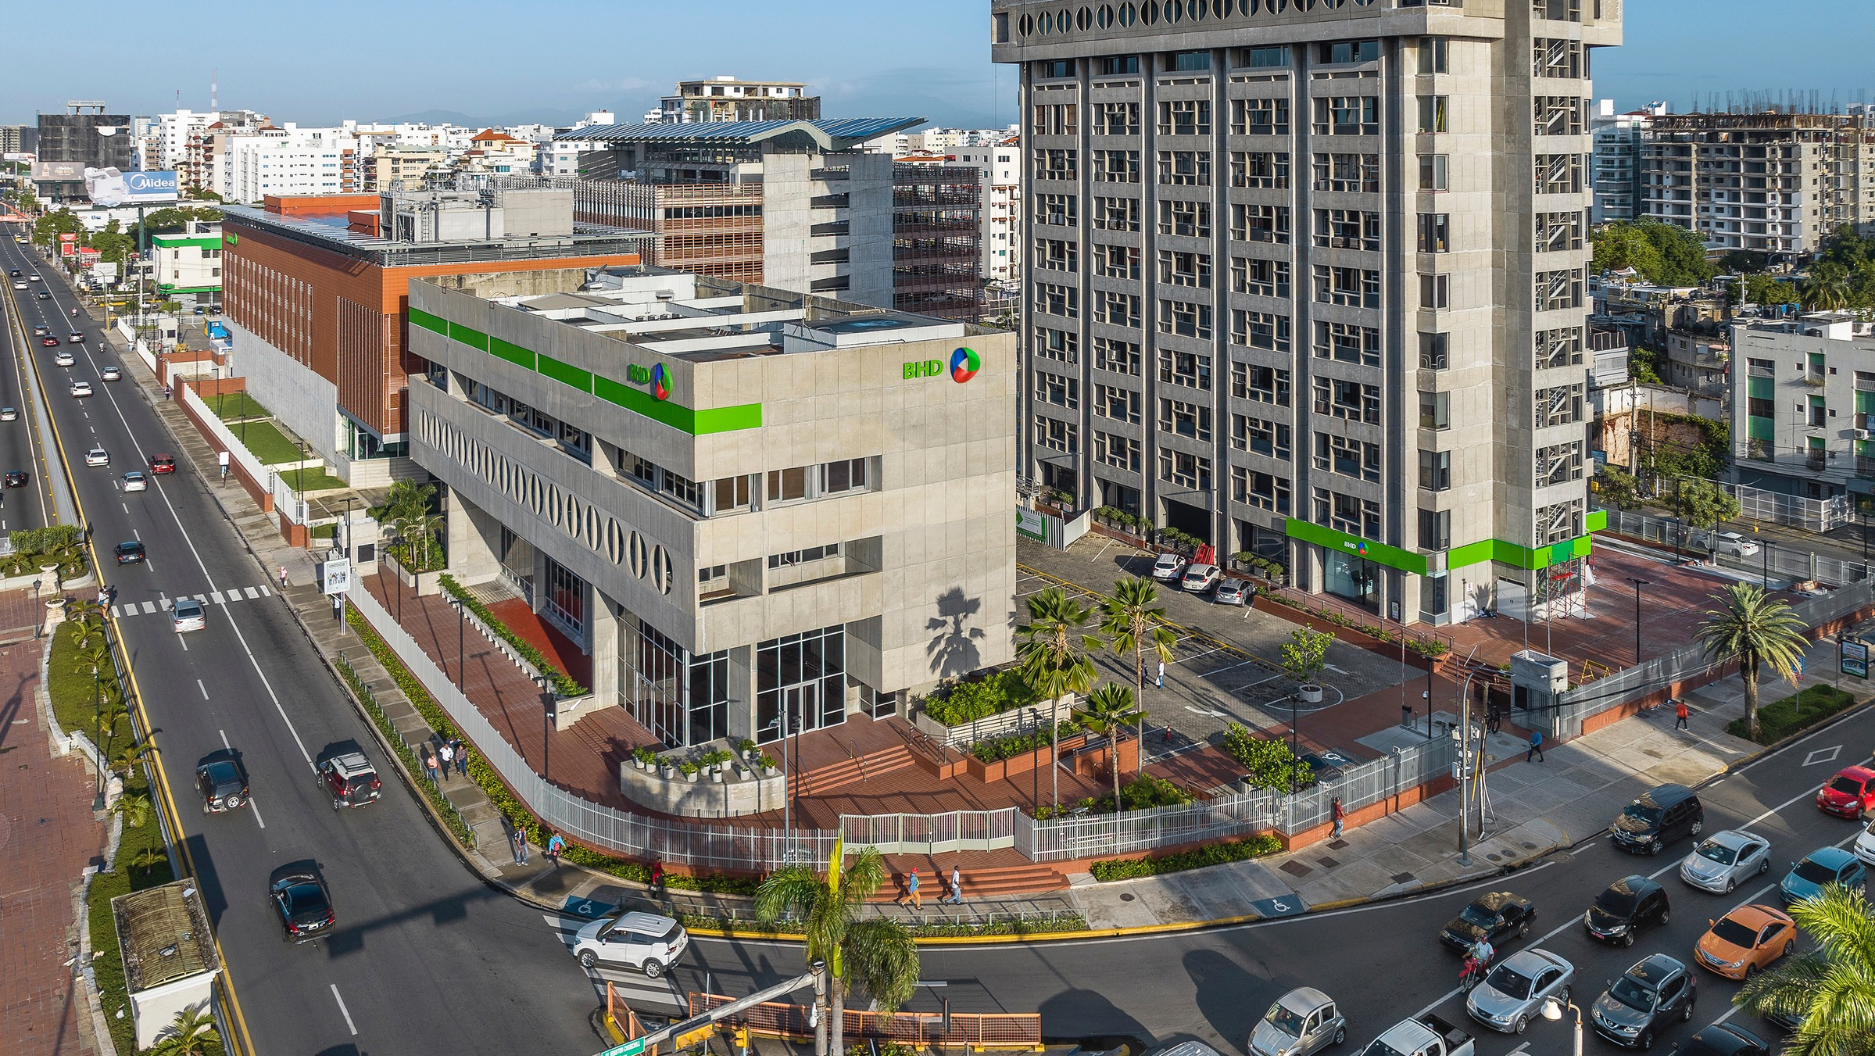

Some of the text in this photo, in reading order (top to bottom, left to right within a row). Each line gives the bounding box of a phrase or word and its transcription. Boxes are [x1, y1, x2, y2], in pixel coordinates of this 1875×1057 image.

[134, 176, 175, 189] Midea
[629, 363, 650, 384] BHD
[903, 359, 944, 379] BHD
[1344, 541, 1356, 550] BHD
